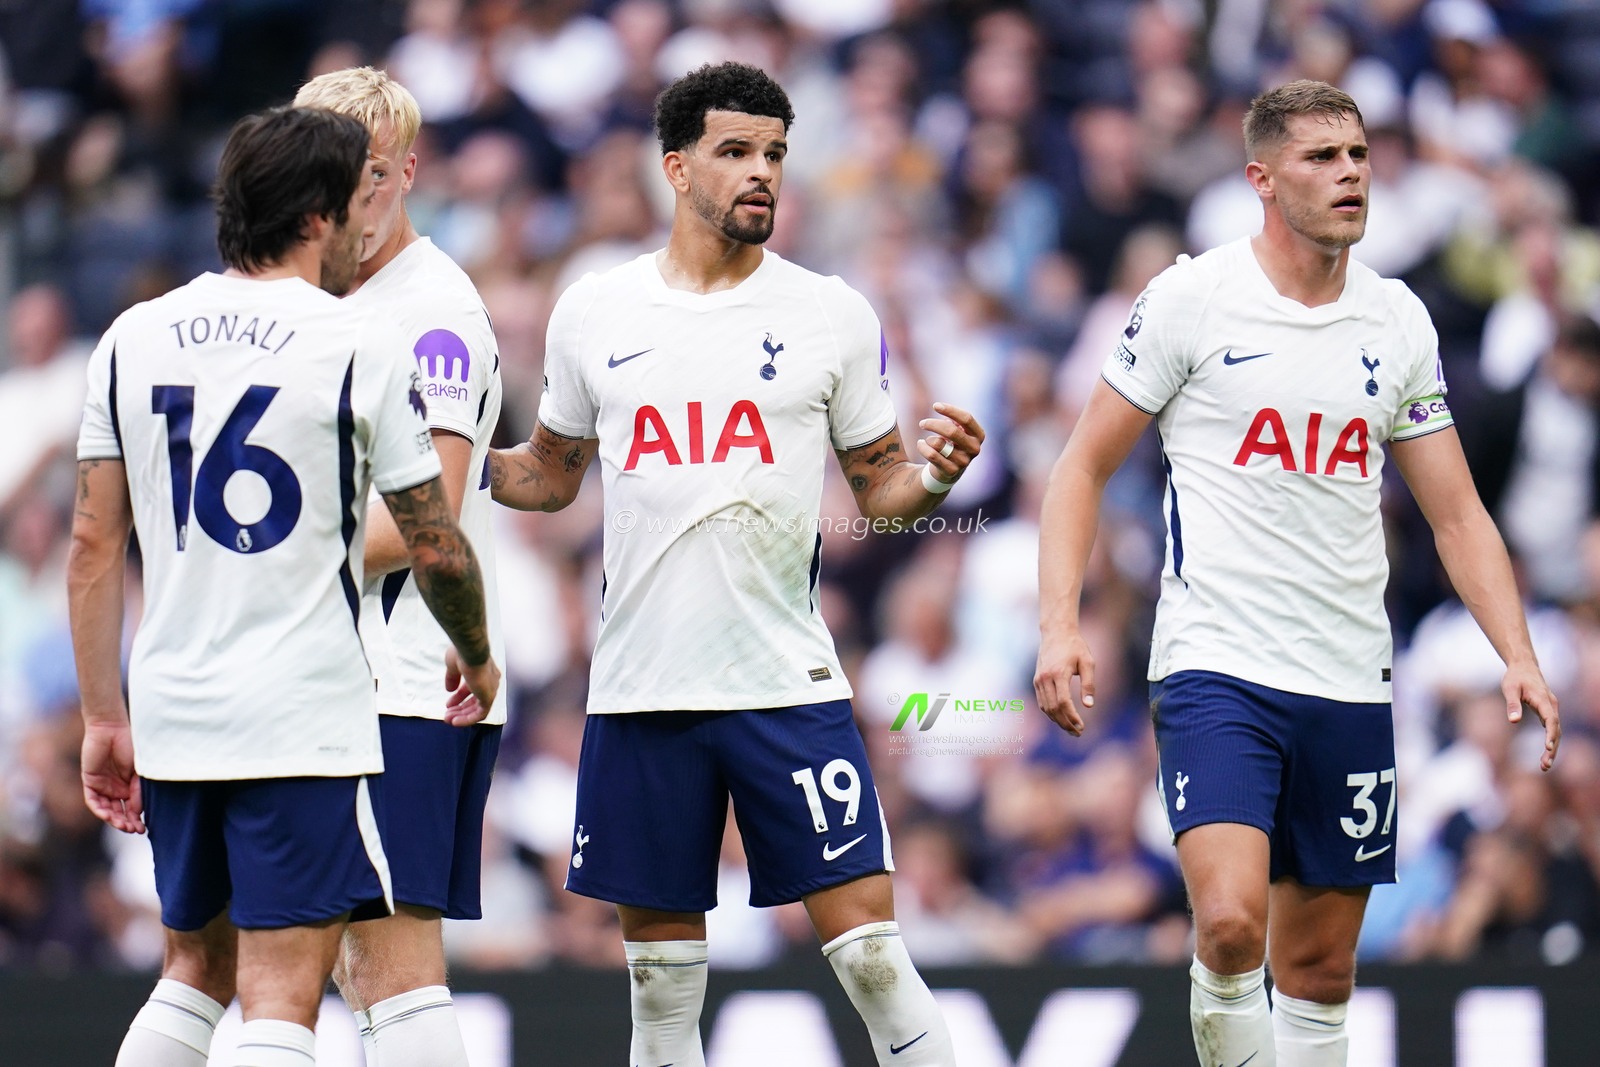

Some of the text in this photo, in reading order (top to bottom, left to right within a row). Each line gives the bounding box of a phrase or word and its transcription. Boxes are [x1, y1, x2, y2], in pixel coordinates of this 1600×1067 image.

[170, 314, 296, 355] TONALI
[424, 383, 468, 401] aken
[152, 385, 302, 554] 16
[623, 400, 775, 471] AIA
[1233, 408, 1370, 478] AIA
[792, 758, 861, 833] 19
[1339, 767, 1396, 838] 37
